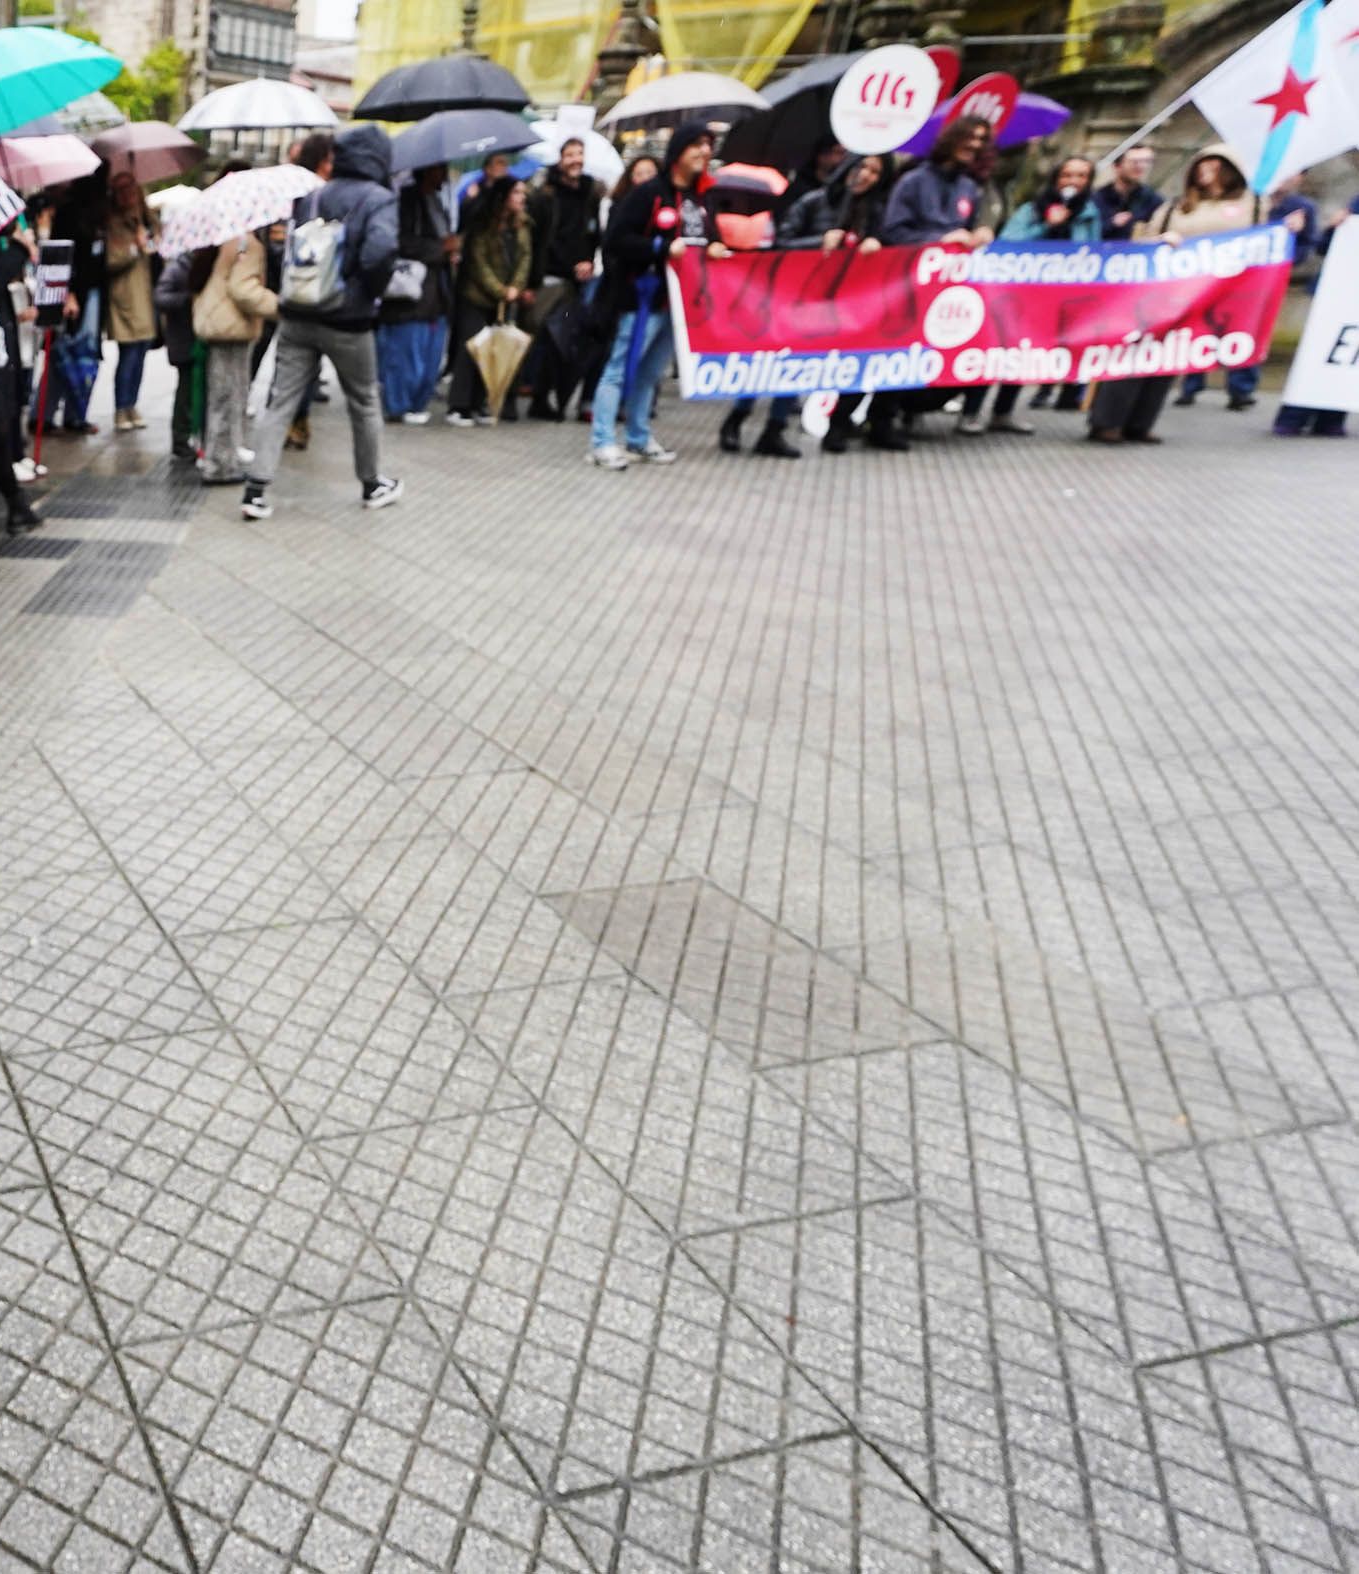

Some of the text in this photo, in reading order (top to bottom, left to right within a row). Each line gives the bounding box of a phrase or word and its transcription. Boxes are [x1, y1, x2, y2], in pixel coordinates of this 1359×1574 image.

[861, 71, 917, 110] CIG
[917, 246, 1101, 285] Profesorado
[1103, 251, 1148, 283] en
[688, 328, 1255, 394] obilízate polo ensino público
